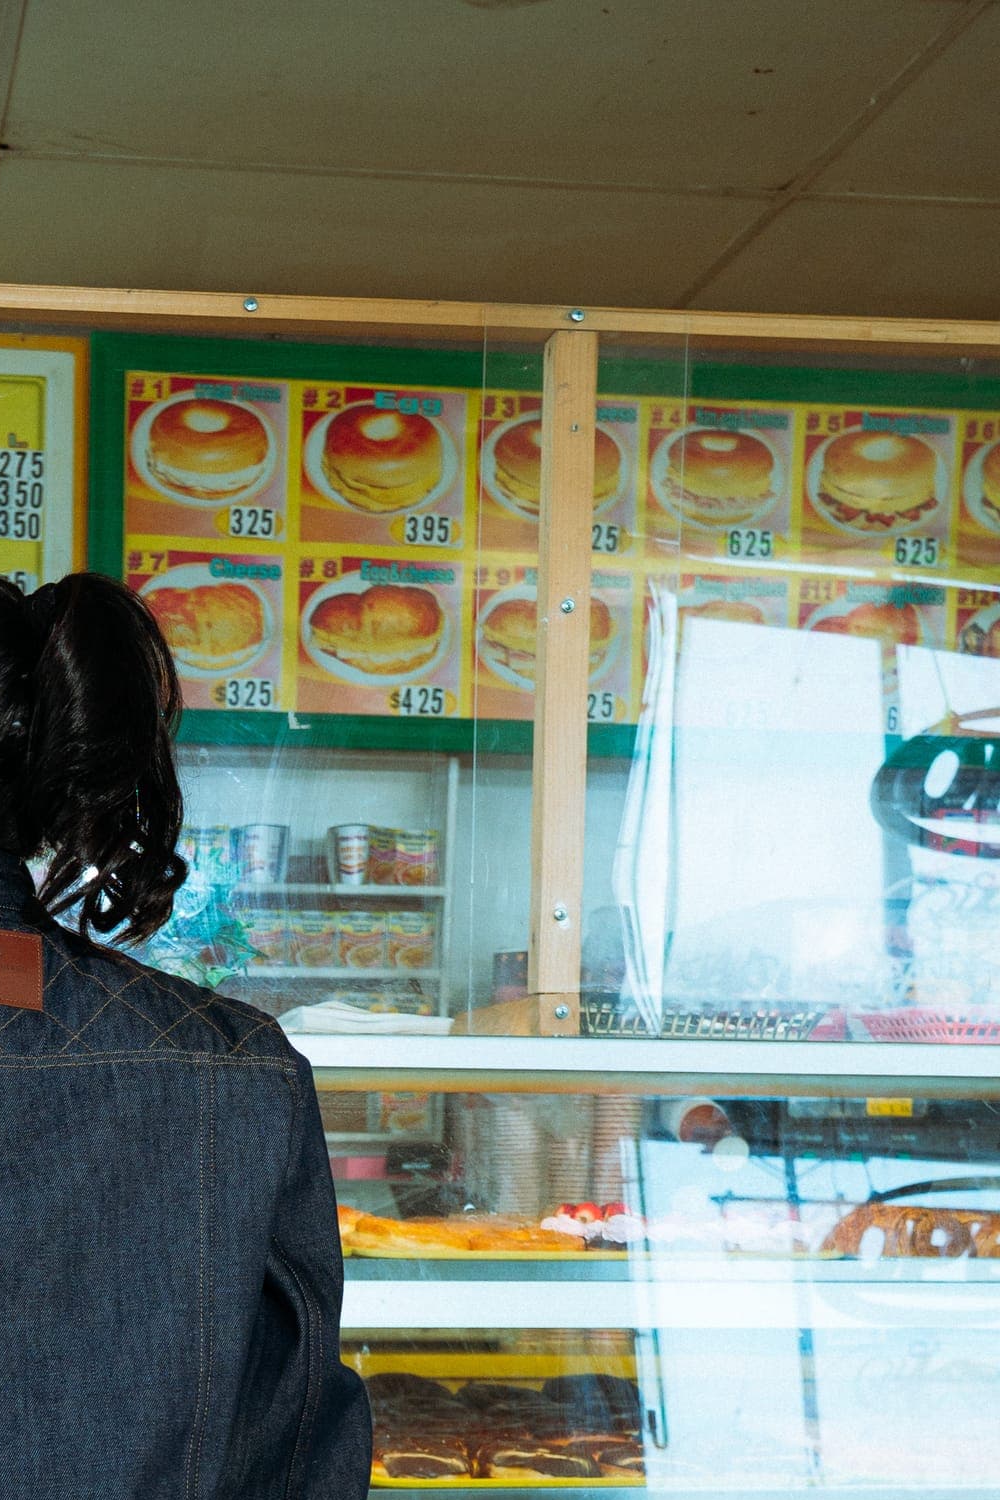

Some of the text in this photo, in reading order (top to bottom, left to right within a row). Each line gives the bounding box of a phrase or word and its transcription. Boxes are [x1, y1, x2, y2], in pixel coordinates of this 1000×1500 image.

[373, 391, 443, 417] Egg
[0, 452, 43, 478] 275
[230, 509, 273, 536] 325
[406, 517, 450, 543] 395
[728, 530, 772, 557] 625
[895, 538, 937, 565] 625
[209, 558, 281, 581] Cheese
